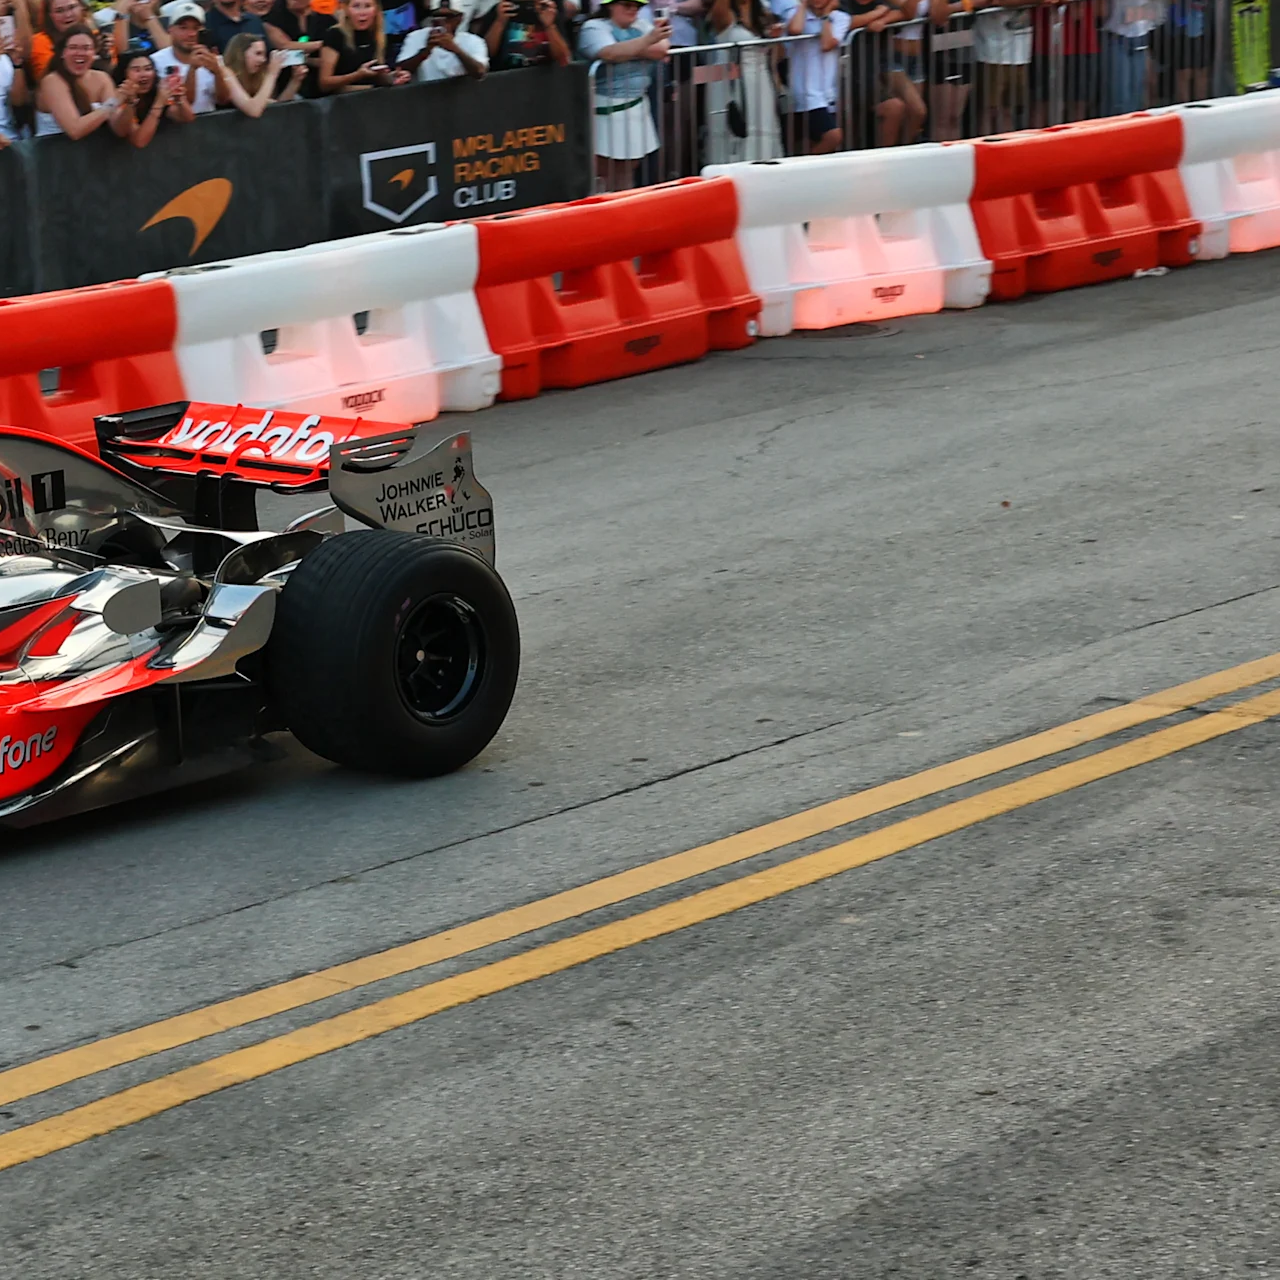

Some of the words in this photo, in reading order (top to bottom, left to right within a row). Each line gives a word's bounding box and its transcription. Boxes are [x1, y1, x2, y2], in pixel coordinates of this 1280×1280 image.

[453, 152, 540, 184] RACING
[453, 179, 517, 208] CLUB
[160, 411, 362, 462] vodafo
[376, 471, 445, 503] JOHNNIE
[380, 493, 448, 523] WALKER
[469, 528, 494, 540] Solar
